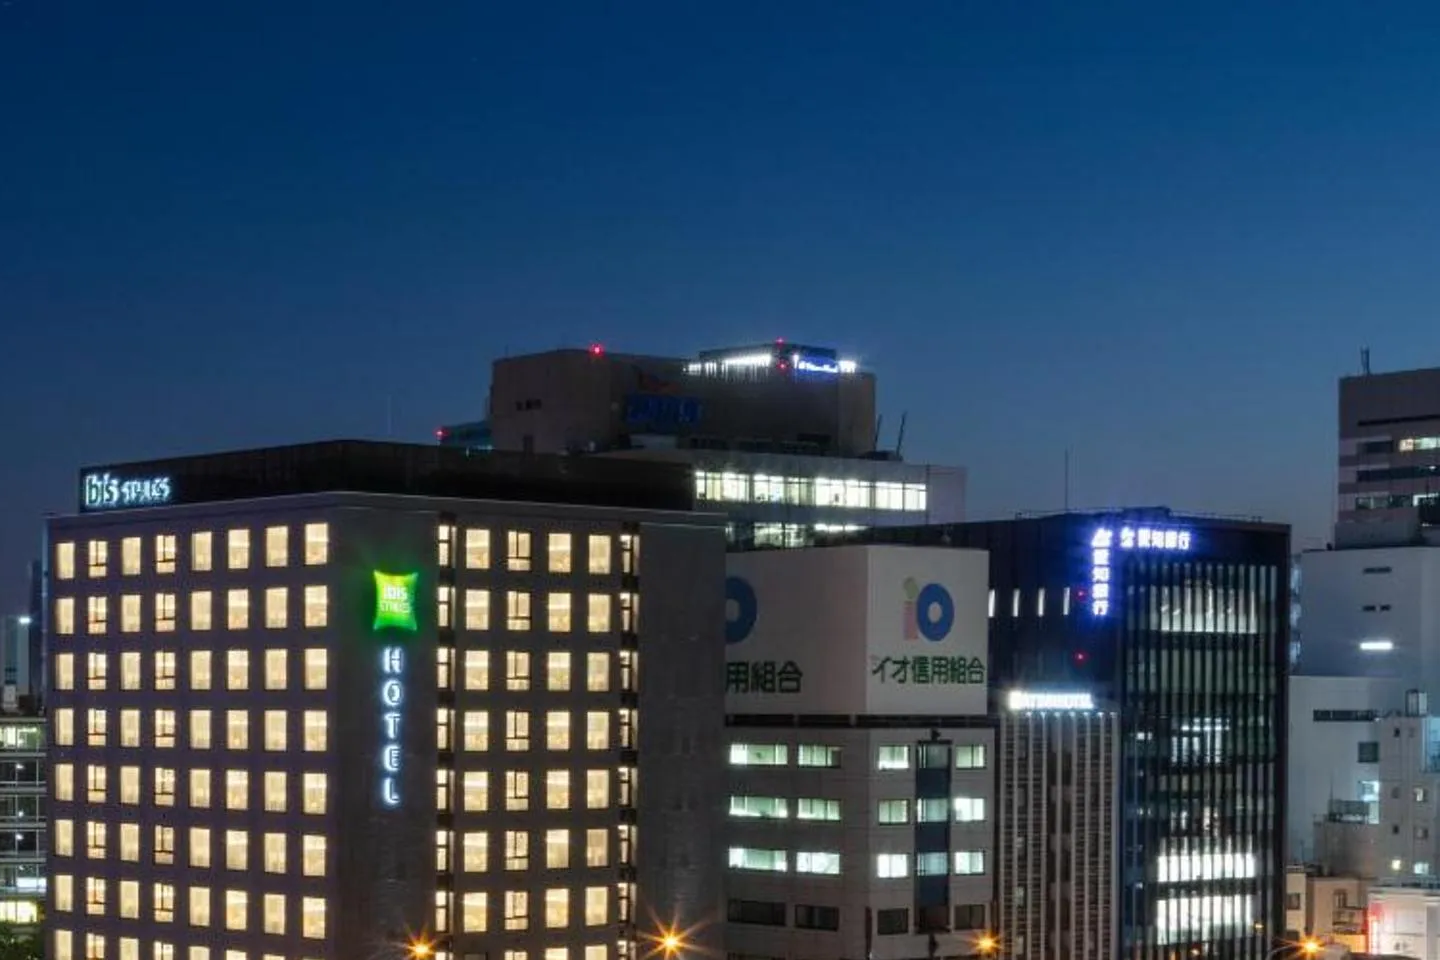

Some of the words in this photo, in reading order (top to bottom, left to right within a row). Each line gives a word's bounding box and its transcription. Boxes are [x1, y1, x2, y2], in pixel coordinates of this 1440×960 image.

[872, 655, 985, 684] イオ信用組合
[382, 646, 404, 805] HOTEL
